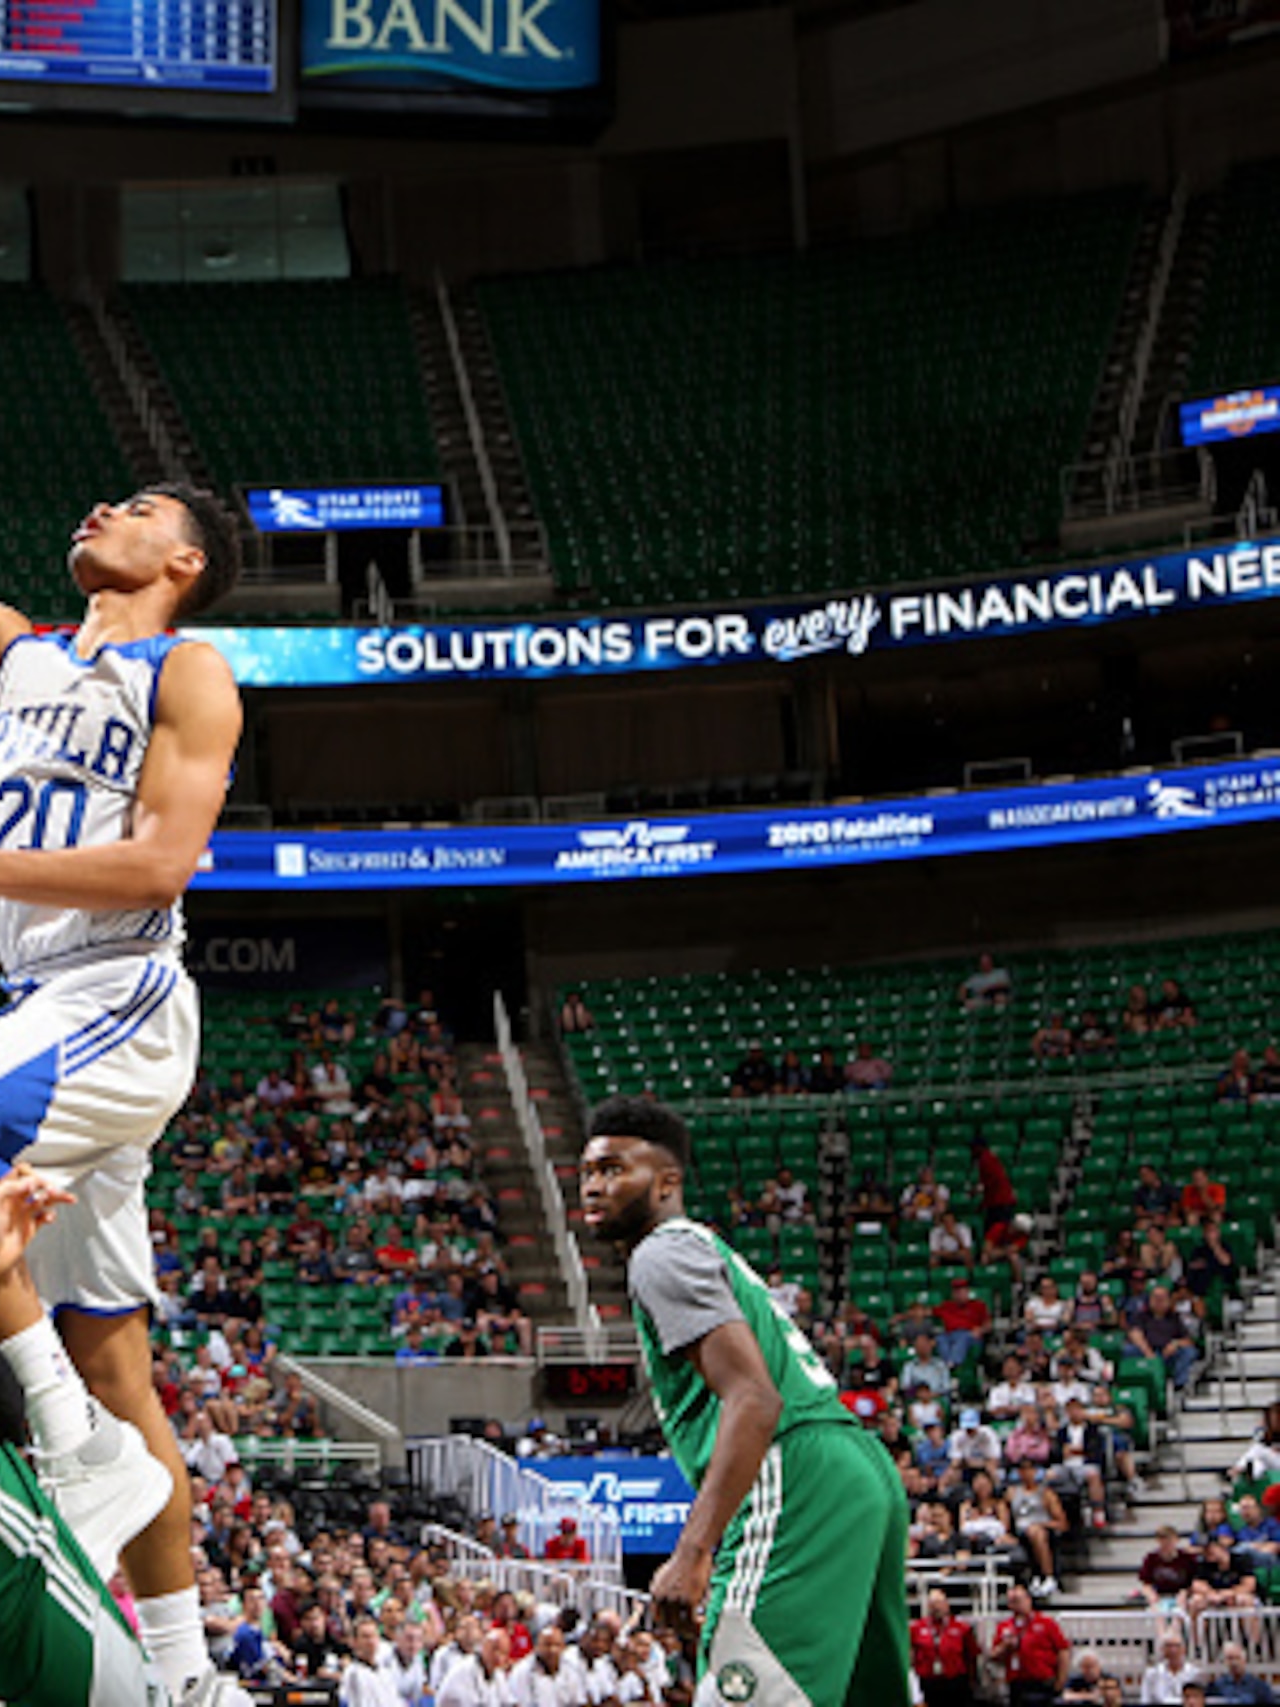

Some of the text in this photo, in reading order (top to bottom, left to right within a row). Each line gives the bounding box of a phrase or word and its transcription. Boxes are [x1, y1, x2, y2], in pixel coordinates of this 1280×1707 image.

[325, 0, 563, 60] BANK
[356, 622, 633, 674] SOLUTIONS
[645, 615, 749, 661] FOR
[762, 594, 883, 656] every
[890, 565, 1176, 638] FINANCIAL
[554, 846, 652, 872] AMERICA
[653, 841, 718, 865] FIRST
[623, 1502, 692, 1524] FIRST
